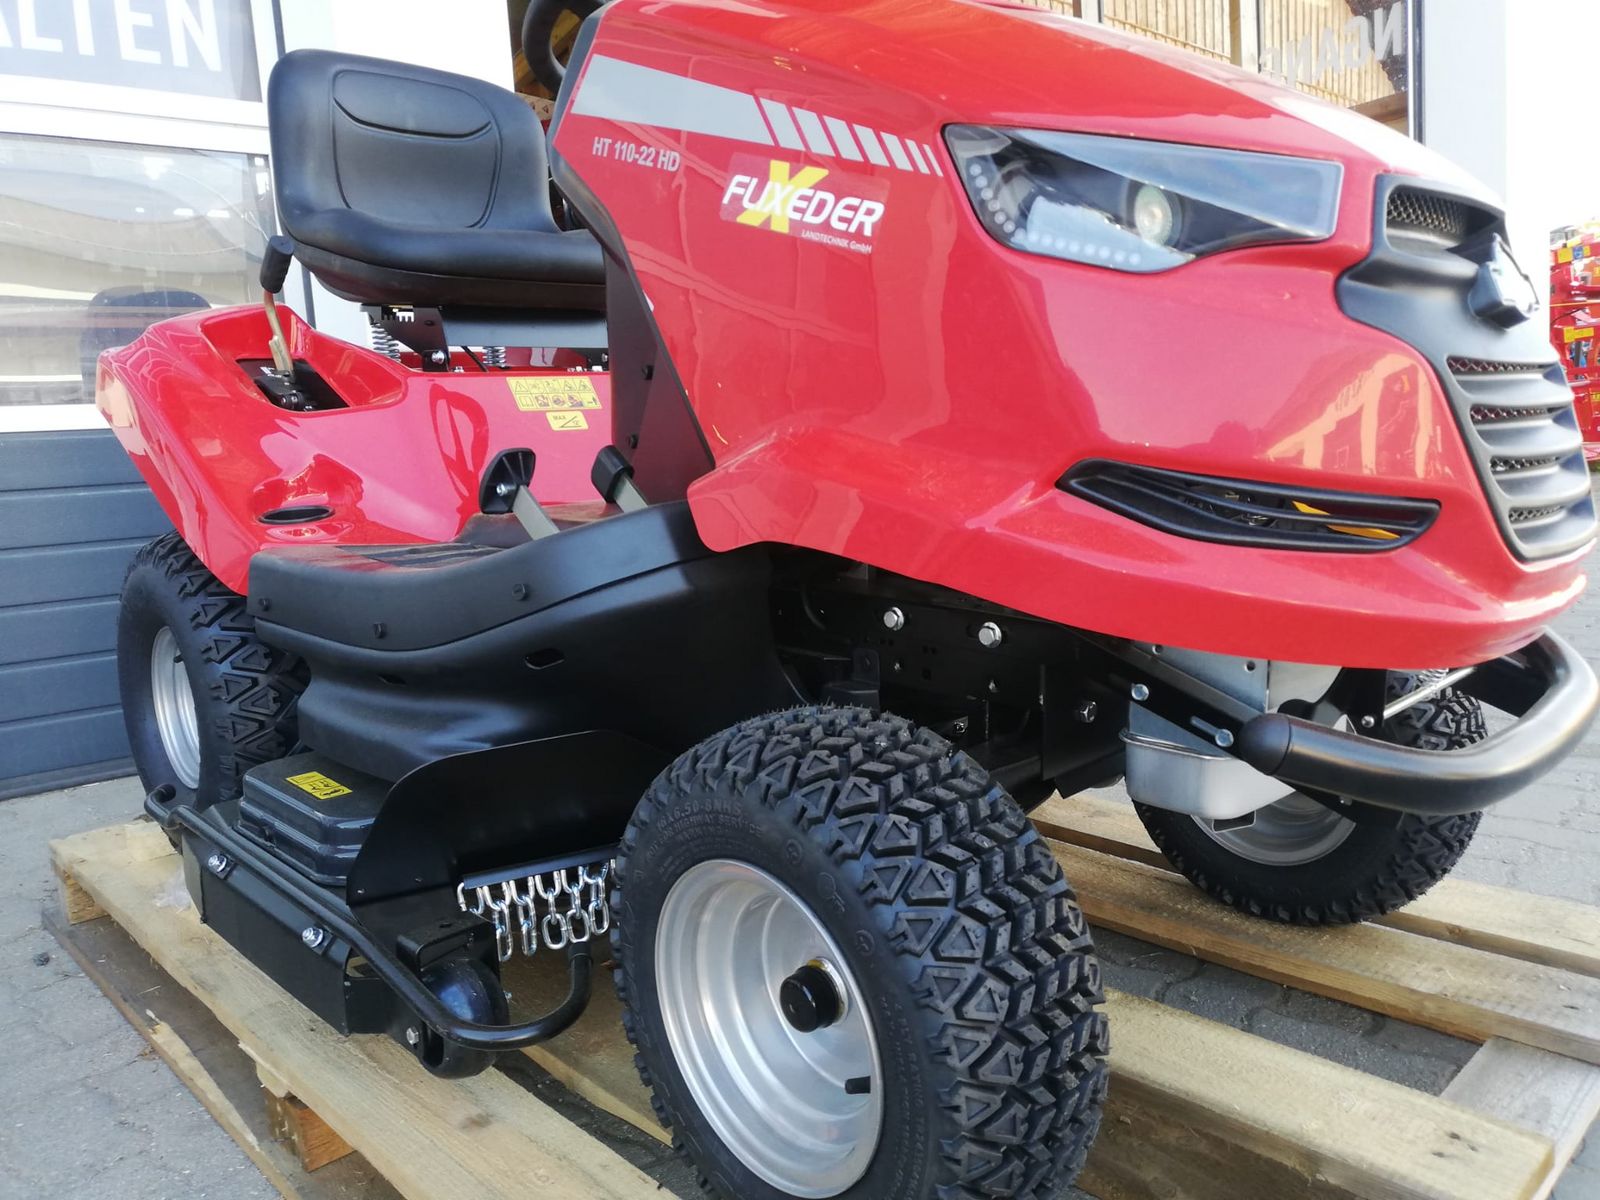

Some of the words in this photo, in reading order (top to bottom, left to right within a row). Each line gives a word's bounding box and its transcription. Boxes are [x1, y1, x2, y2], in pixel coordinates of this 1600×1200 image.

[0, 0, 222, 72] LTEN
[592, 136, 612, 158] HT
[614, 140, 656, 167] 110-22
[657, 149, 681, 172] HD
[722, 160, 885, 237] FUXEDER
[801, 229, 849, 248] LANDTECHNIK
[849, 240, 873, 254] GmbH
